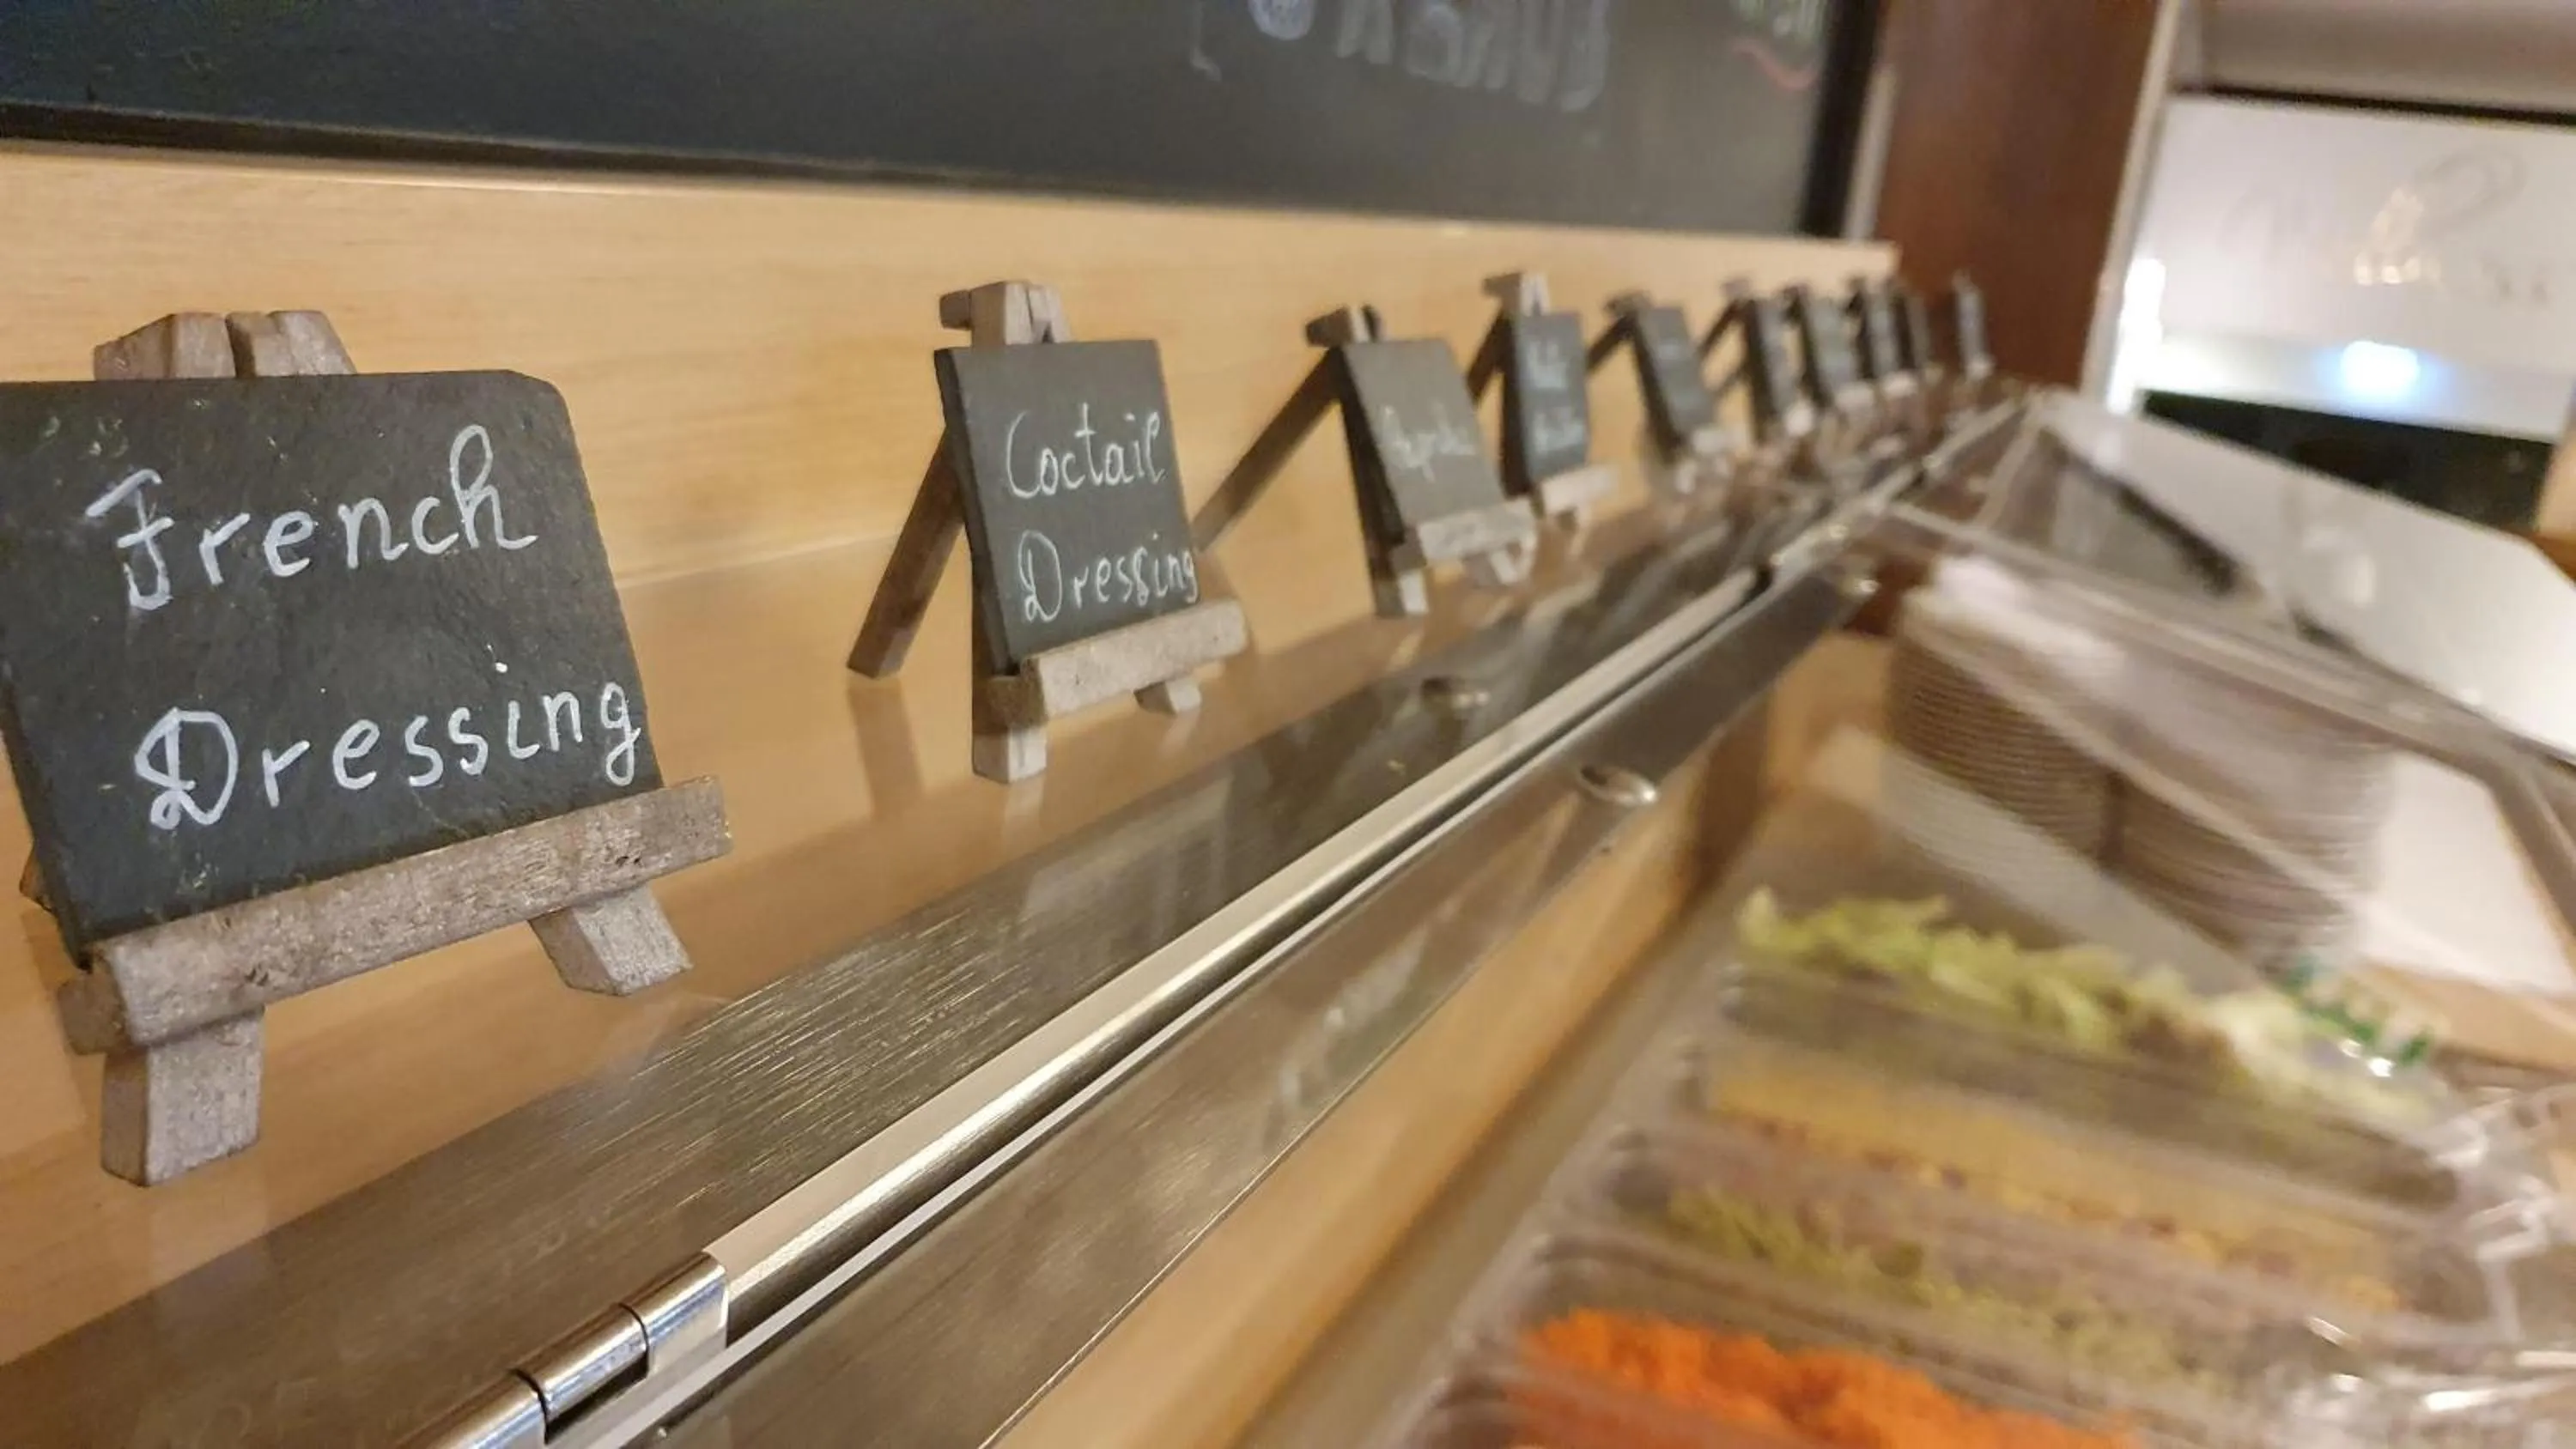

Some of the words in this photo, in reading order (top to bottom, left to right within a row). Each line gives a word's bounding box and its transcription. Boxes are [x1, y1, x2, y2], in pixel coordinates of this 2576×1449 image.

[86, 424, 538, 610] French
[1006, 403, 1165, 498] Coctail
[1017, 530, 1199, 621] Dressing
[134, 658, 641, 830] Dressing
